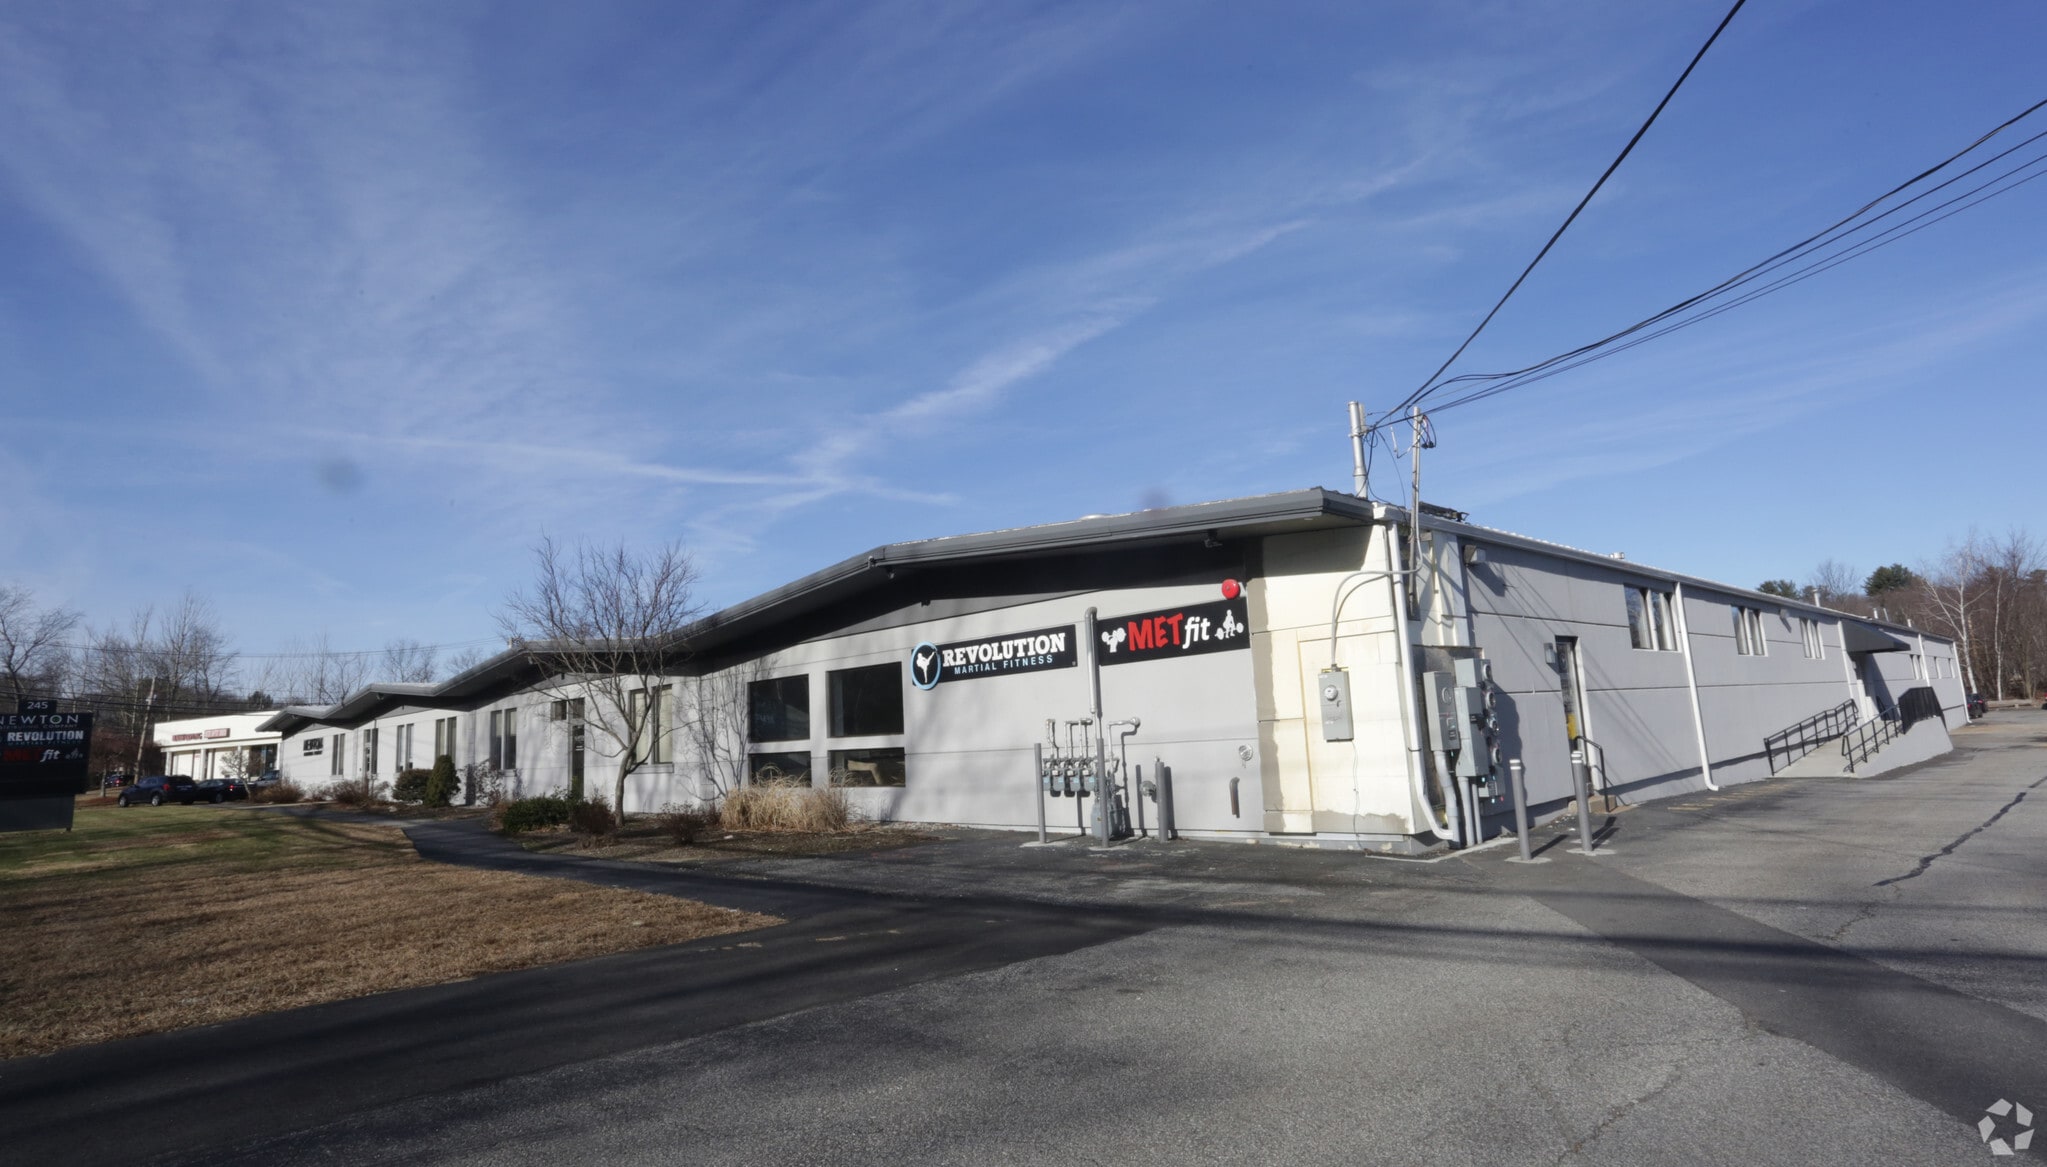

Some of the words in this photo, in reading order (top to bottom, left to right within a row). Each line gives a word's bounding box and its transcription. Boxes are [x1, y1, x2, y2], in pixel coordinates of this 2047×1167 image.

[1127, 612, 1211, 652] METfit
[942, 632, 1066, 668] REVOLUTION
[954, 662, 997, 675] MARTIAL
[1003, 654, 1053, 669] FITNESS
[26, 701, 49, 710] 245
[7, 730, 84, 742] REVOLUTION
